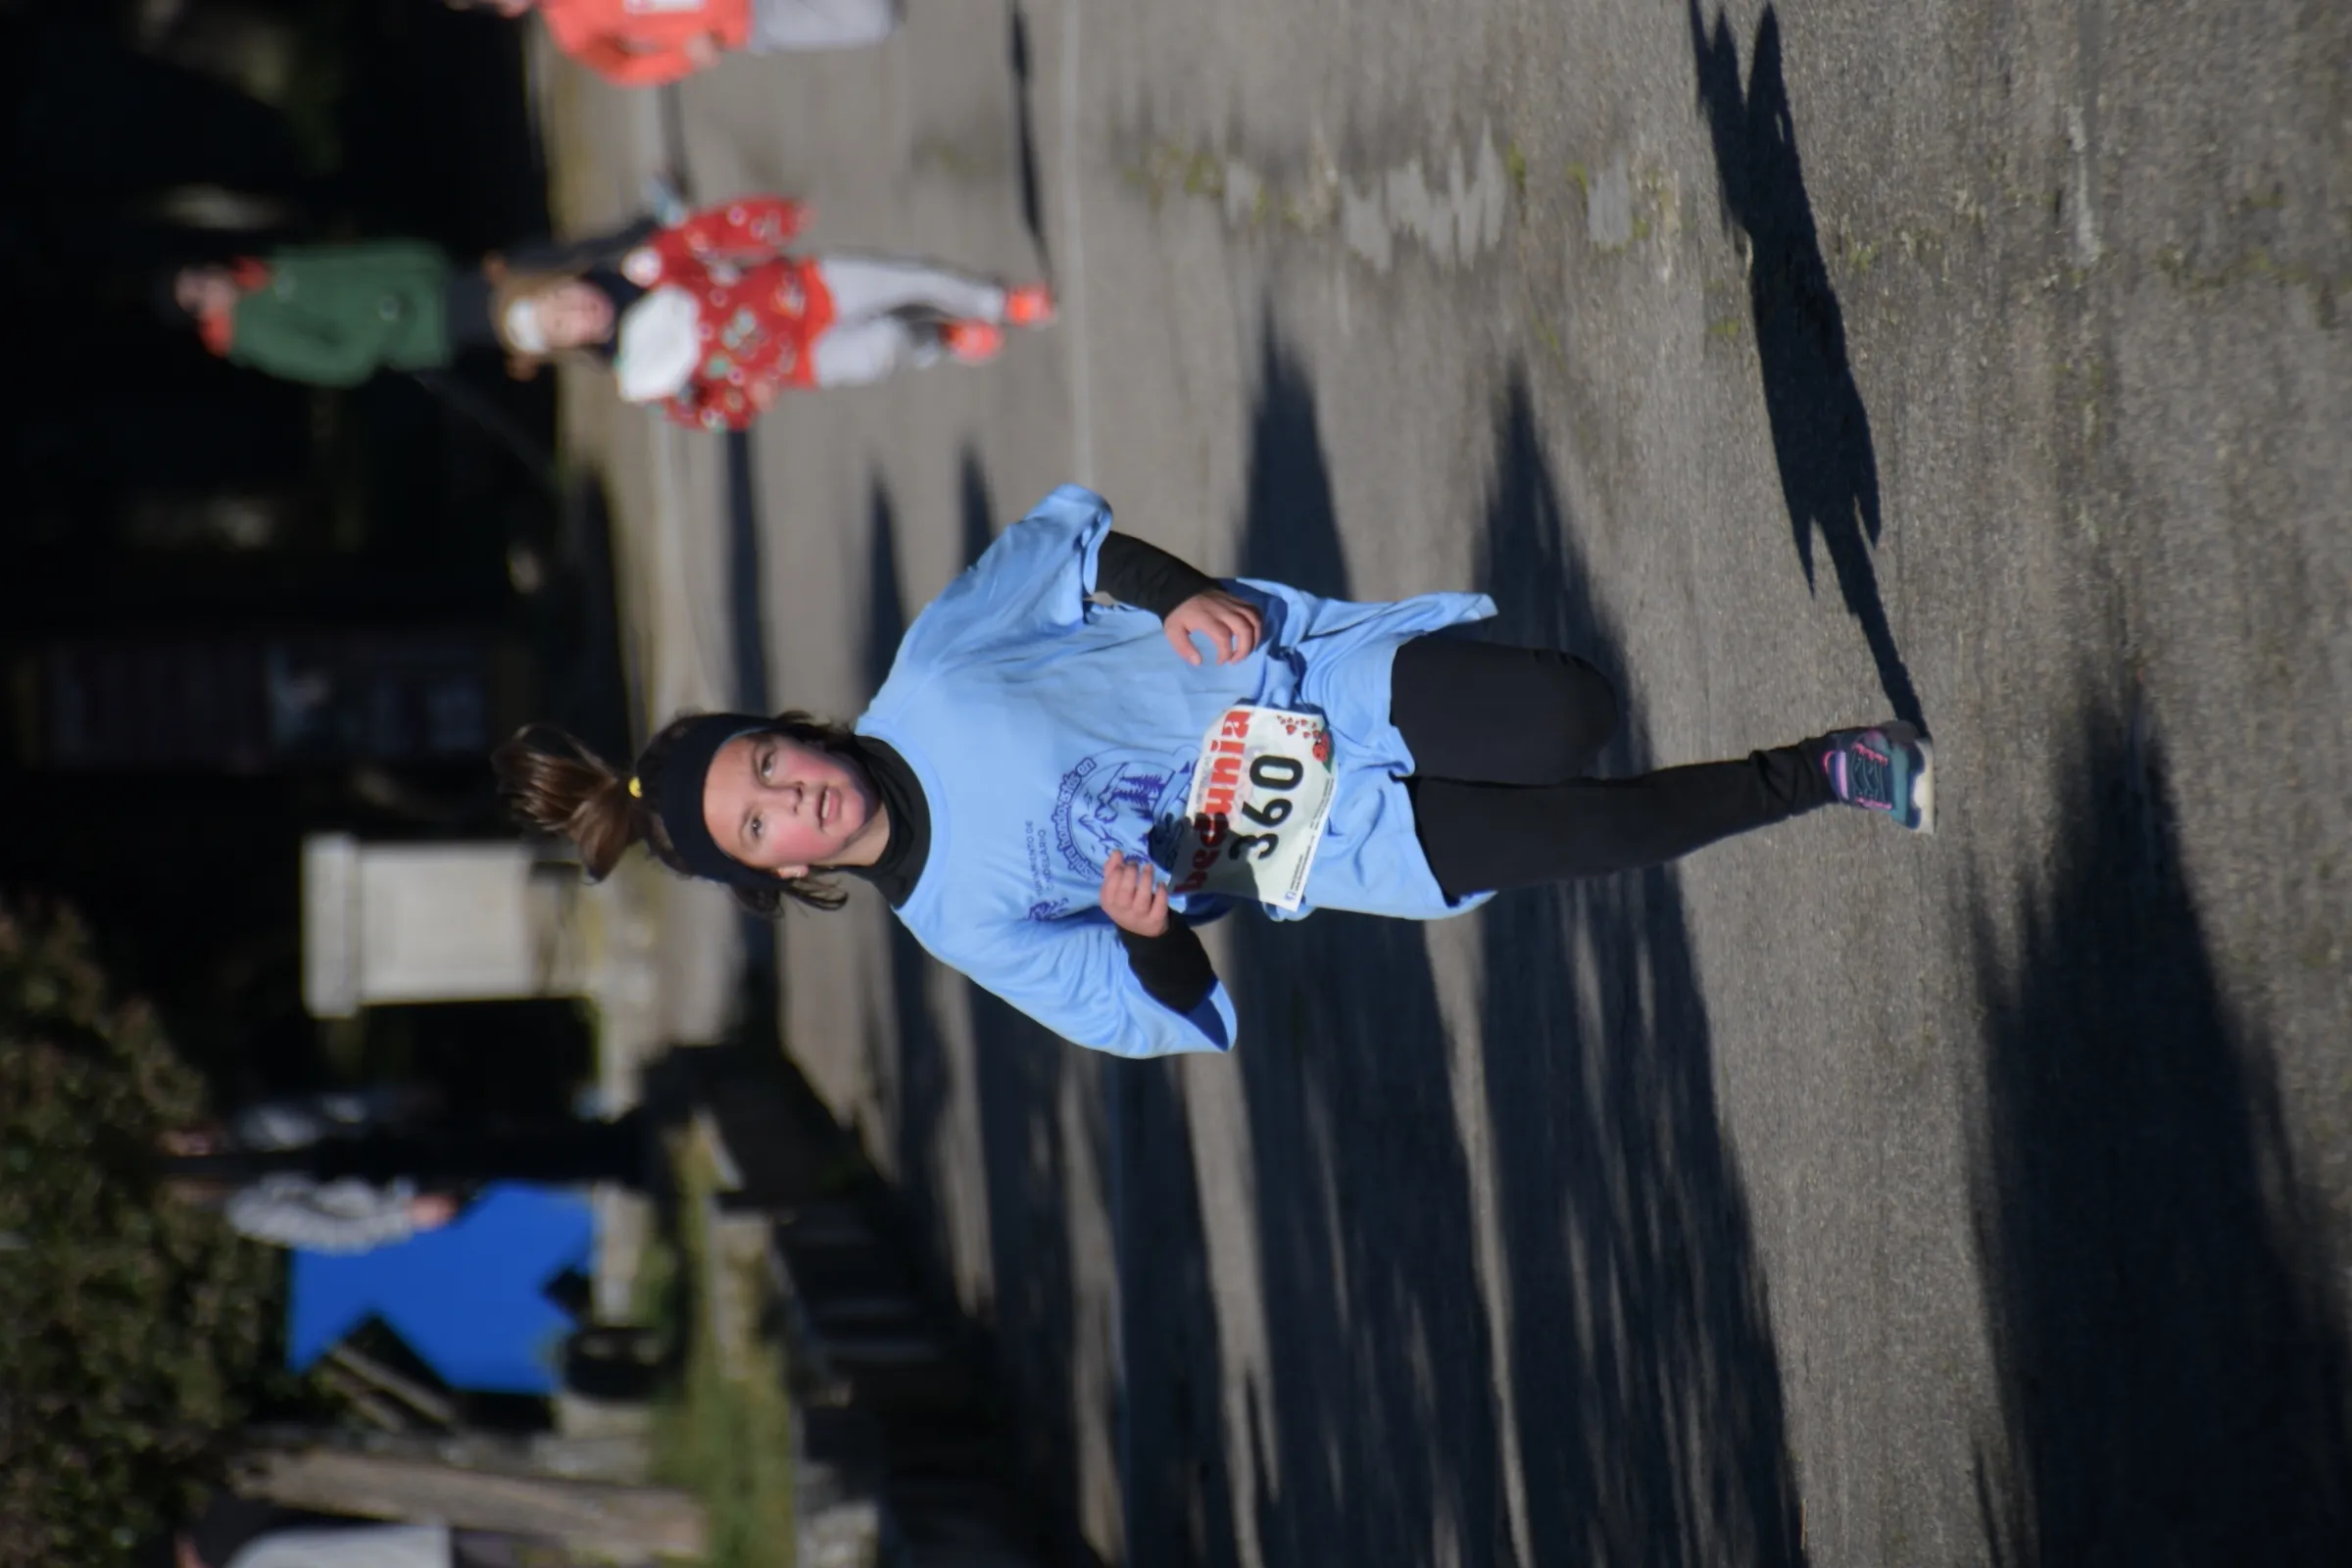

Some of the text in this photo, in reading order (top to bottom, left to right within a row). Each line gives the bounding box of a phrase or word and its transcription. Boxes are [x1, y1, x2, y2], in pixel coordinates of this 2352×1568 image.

[1074, 756, 1097, 778] en
[1172, 710, 1250, 893] bedunia
[1227, 753, 1303, 859] 360
